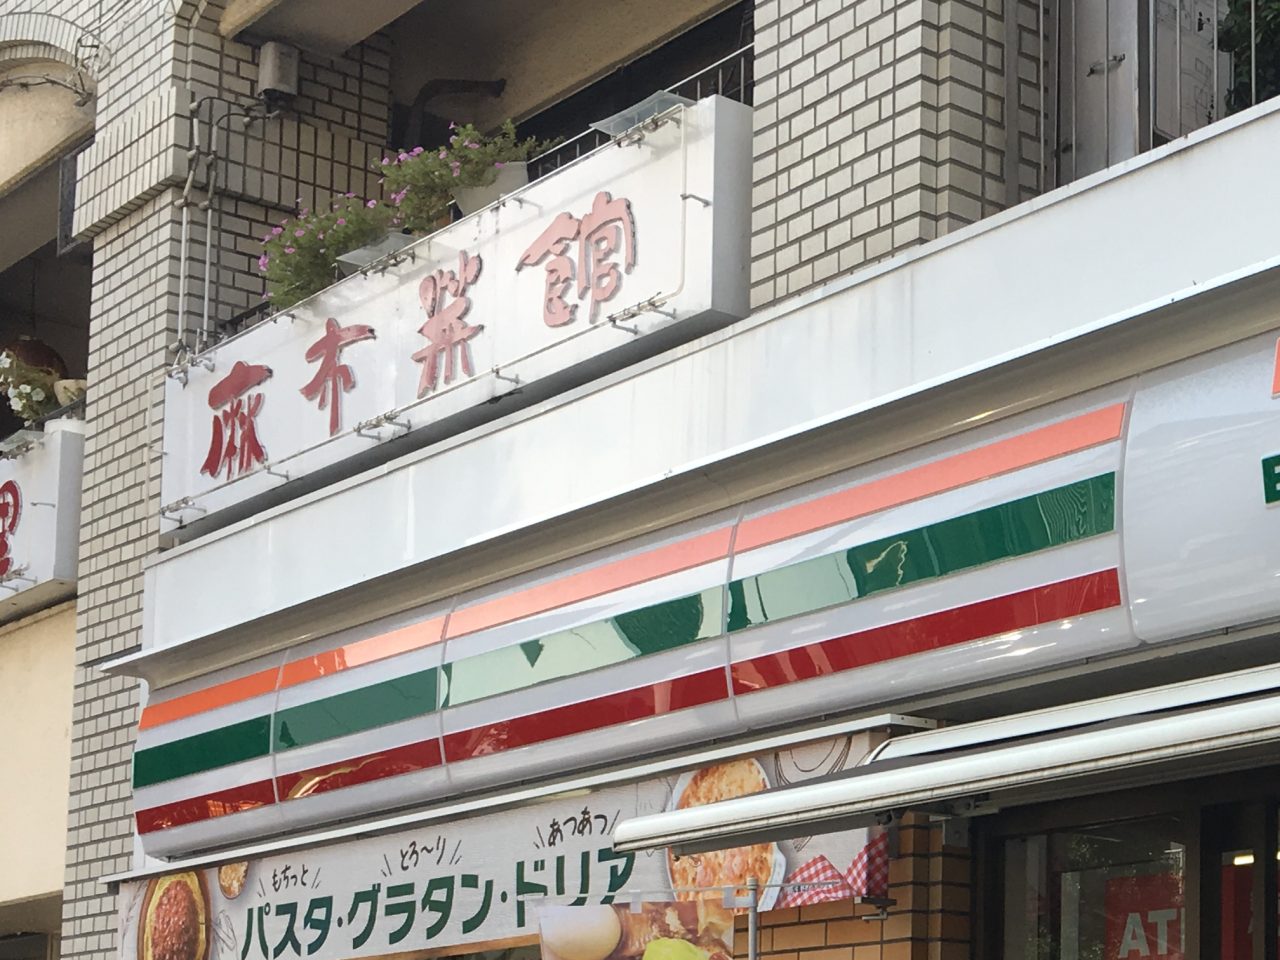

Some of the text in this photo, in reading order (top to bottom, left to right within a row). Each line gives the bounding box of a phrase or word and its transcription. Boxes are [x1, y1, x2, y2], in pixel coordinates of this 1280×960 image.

[547, 806, 609, 848] あつあつ
[270, 862, 310, 892] もちっと
[1118, 908, 1185, 960] AT
